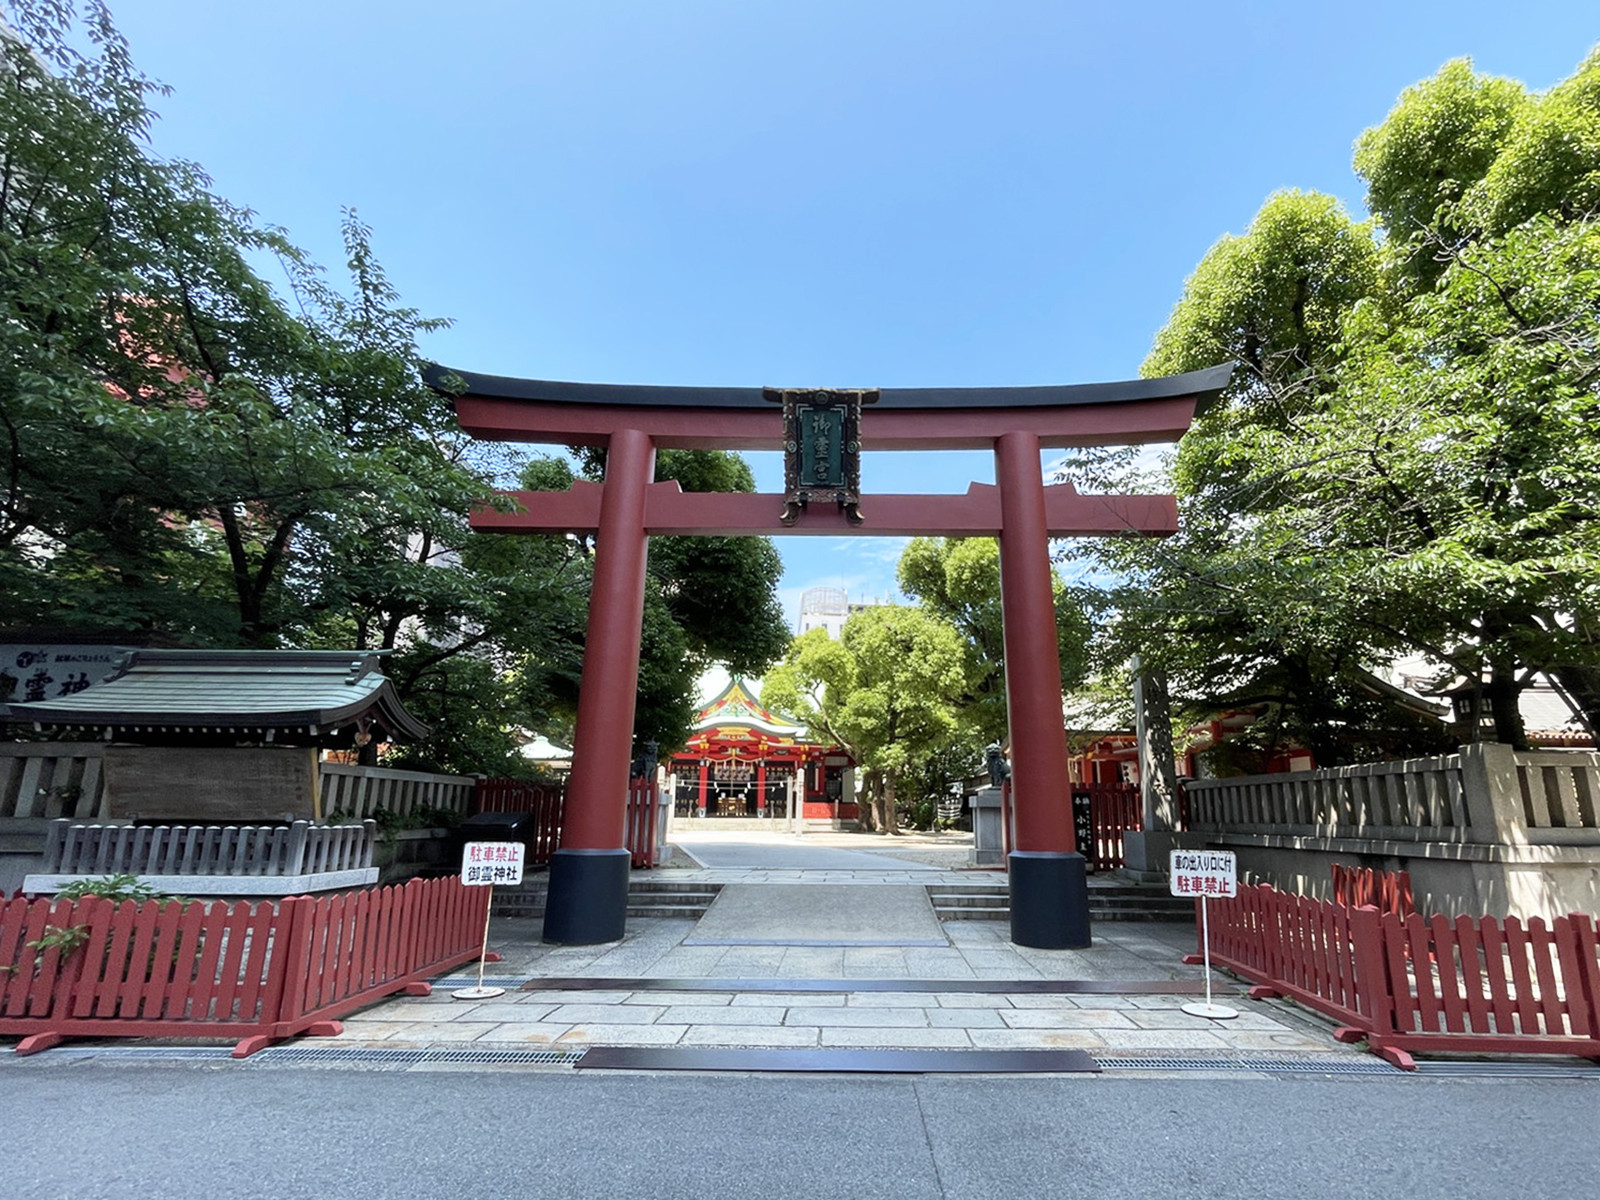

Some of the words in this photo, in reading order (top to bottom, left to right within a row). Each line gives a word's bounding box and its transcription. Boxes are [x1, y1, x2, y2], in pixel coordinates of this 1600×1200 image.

[469, 845, 519, 862] 駐車禁止
[1174, 854, 1232, 873] 車の出入り口に付
[467, 865, 518, 882] 御霊神社
[1176, 874, 1232, 894] 駐車禁止
